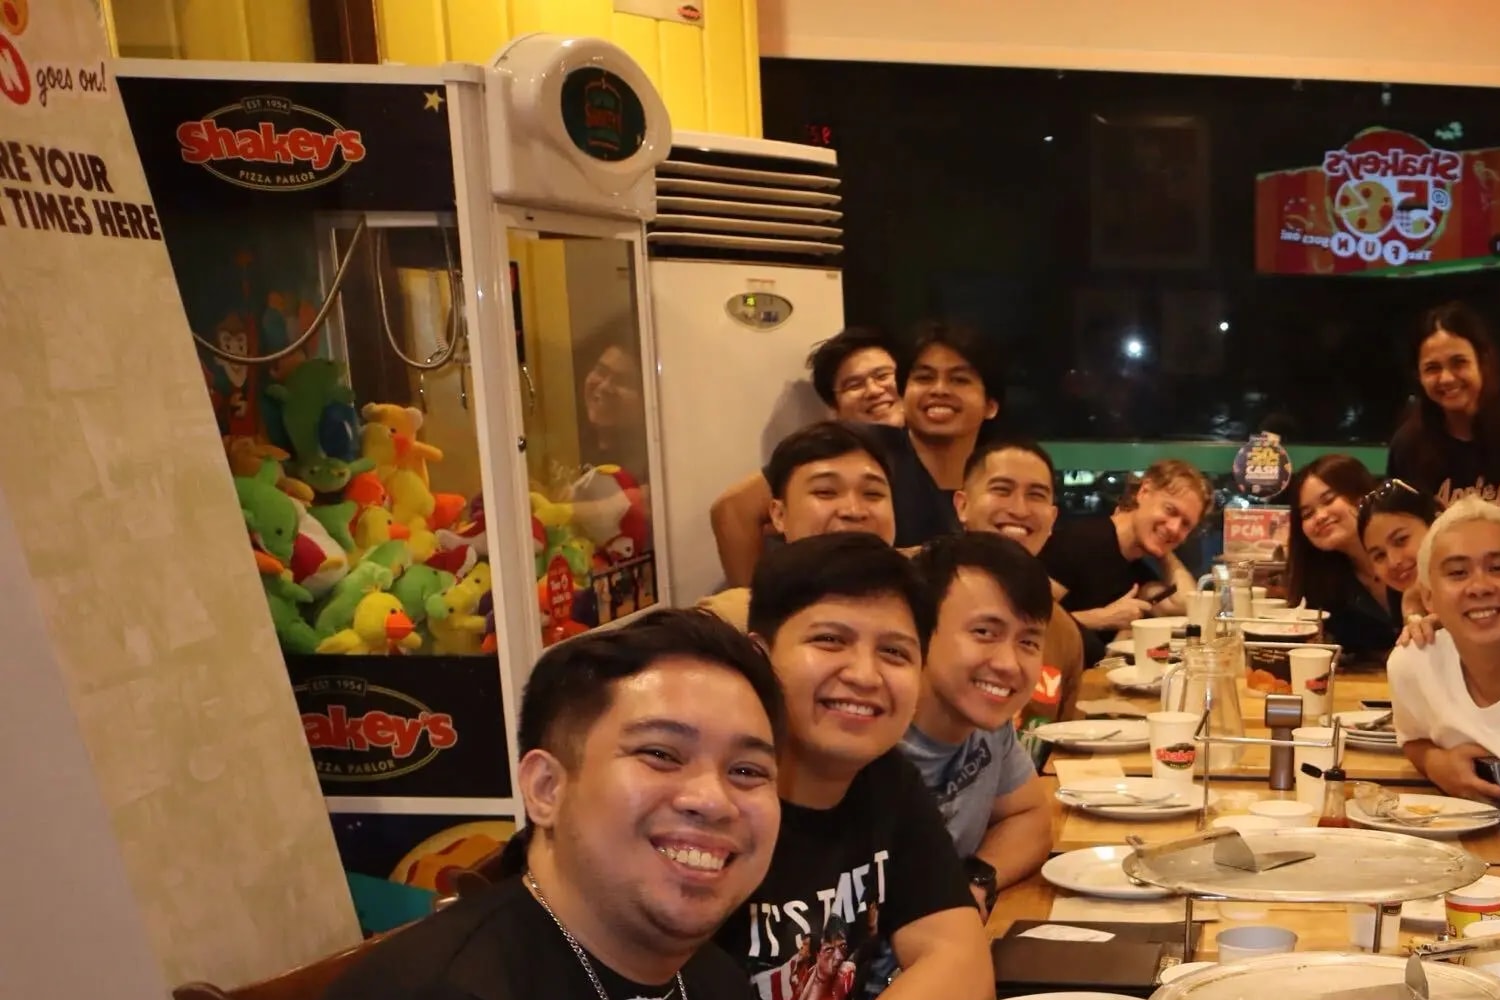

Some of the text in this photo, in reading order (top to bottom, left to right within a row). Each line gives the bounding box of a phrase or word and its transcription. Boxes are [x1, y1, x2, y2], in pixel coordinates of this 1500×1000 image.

[36, 65, 73, 107] goes
[79, 62, 107, 92] on!
[176, 118, 366, 171] Shakey's
[27, 144, 114, 193] YOUR
[239, 170, 316, 185] PIZZA PARLOR
[4, 187, 162, 241] TIMES HERE
[1230, 523, 1265, 538] PCM
[348, 760, 395, 774] PARLOR
[748, 899, 811, 957] IT'S
